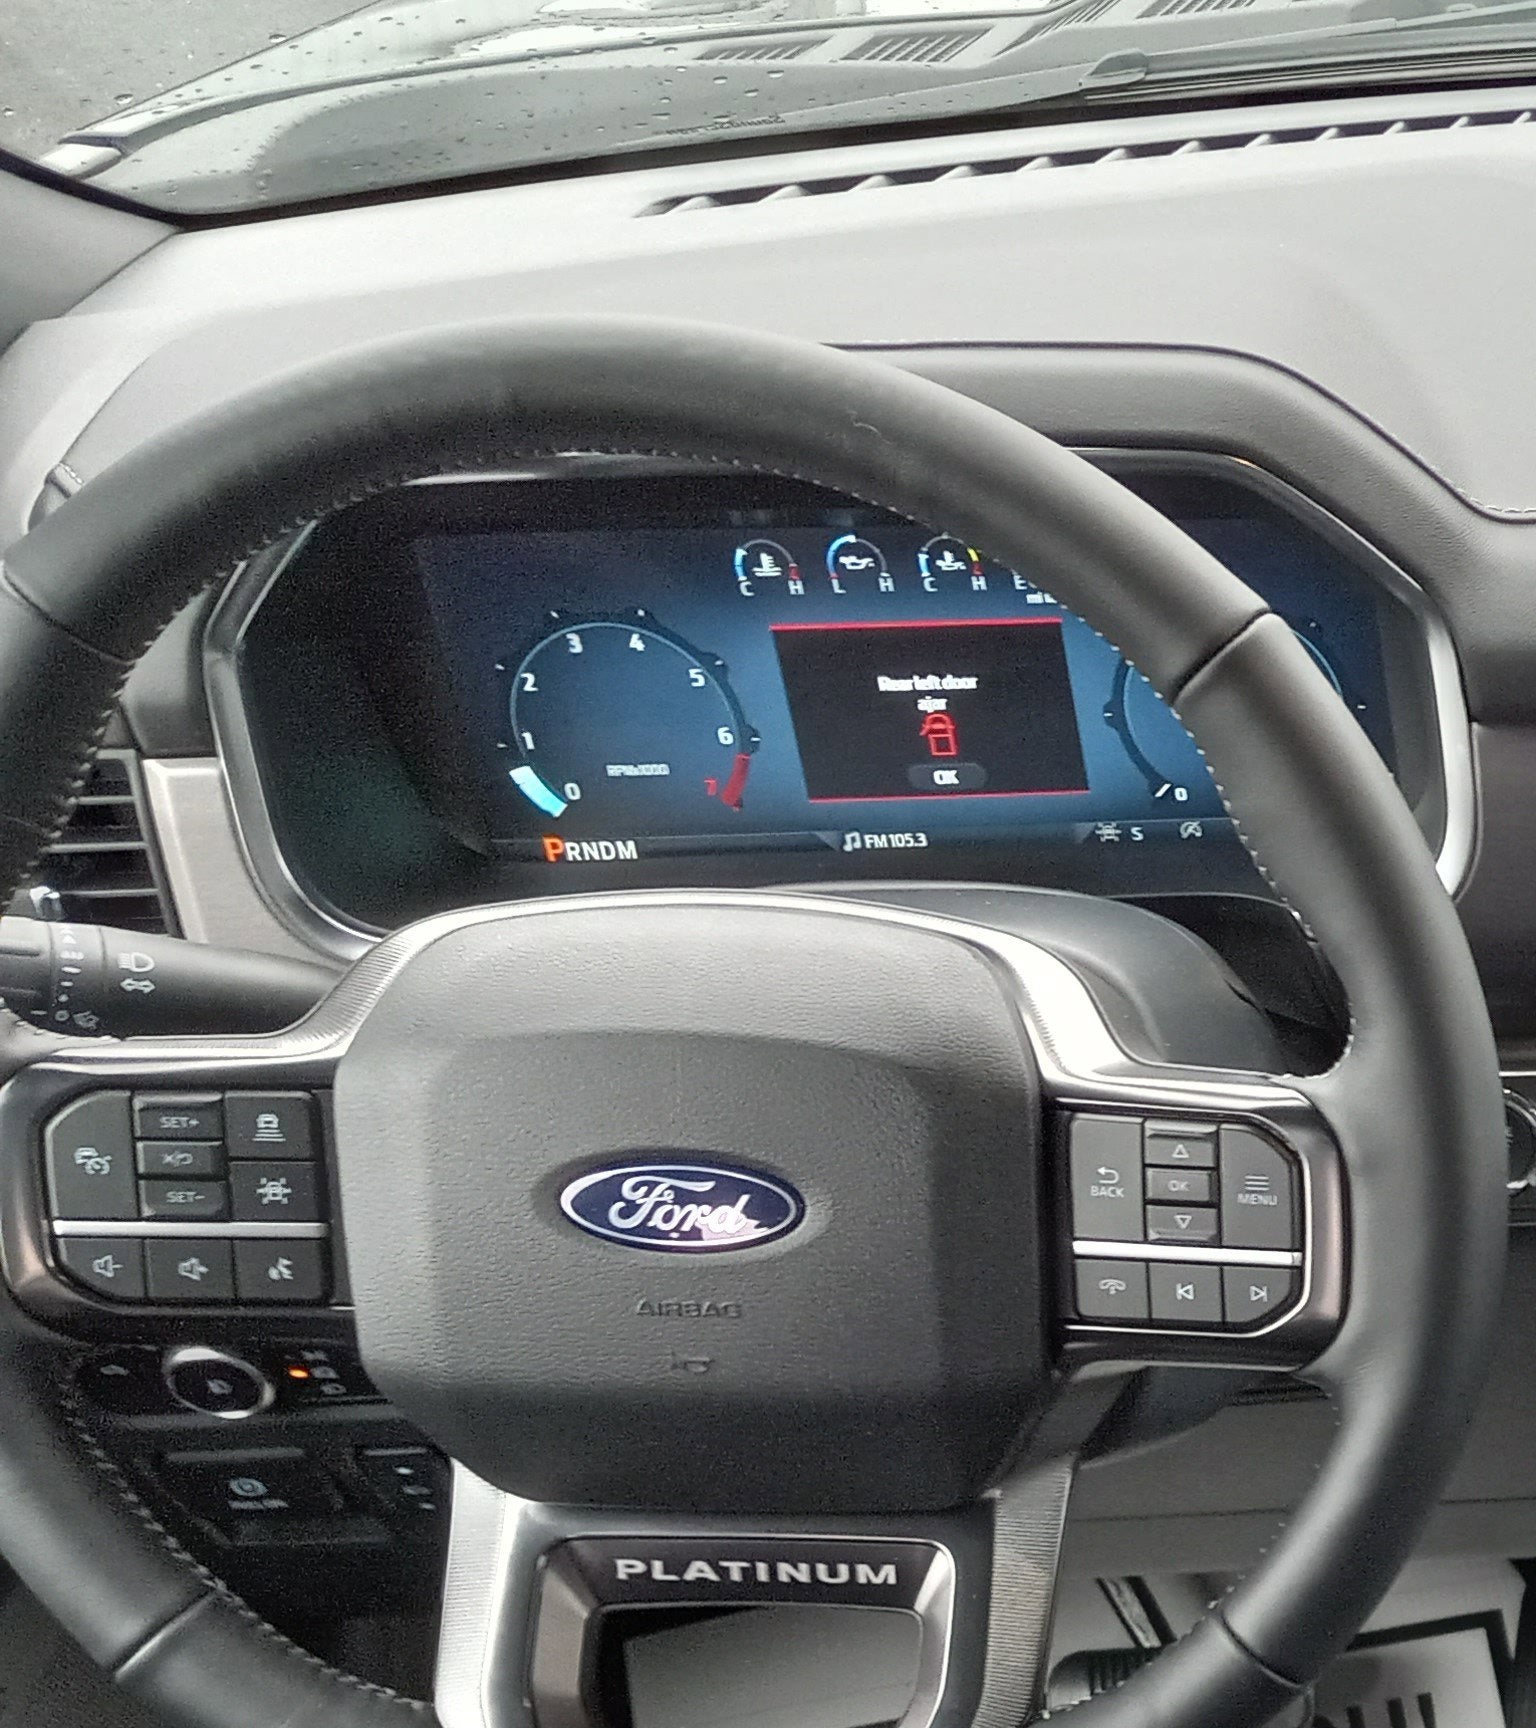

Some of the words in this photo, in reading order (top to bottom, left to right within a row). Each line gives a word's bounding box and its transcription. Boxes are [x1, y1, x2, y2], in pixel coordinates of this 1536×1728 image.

[741, 582, 754, 596] C
[788, 580, 804, 595] H
[880, 578, 895, 592] H
[924, 578, 938, 592] C
[972, 576, 987, 590] H
[566, 633, 583, 654] 3
[629, 633, 645, 651] 4
[520, 673, 538, 692] 2
[689, 668, 706, 687] 5
[521, 731, 535, 750] 1
[717, 727, 734, 745] 6
[933, 769, 960, 785] OK
[563, 783, 581, 801] 0
[864, 834, 888, 848] FM
[888, 832, 928, 848] 105.3
[1131, 826, 1145, 841] S
[1090, 1184, 1125, 1199] BACK
[1168, 1179, 1190, 1192] OK
[607, 1174, 770, 1236] Ford
[1237, 1193, 1279, 1206] MENU
[615, 1557, 898, 1586] PLATINUM
